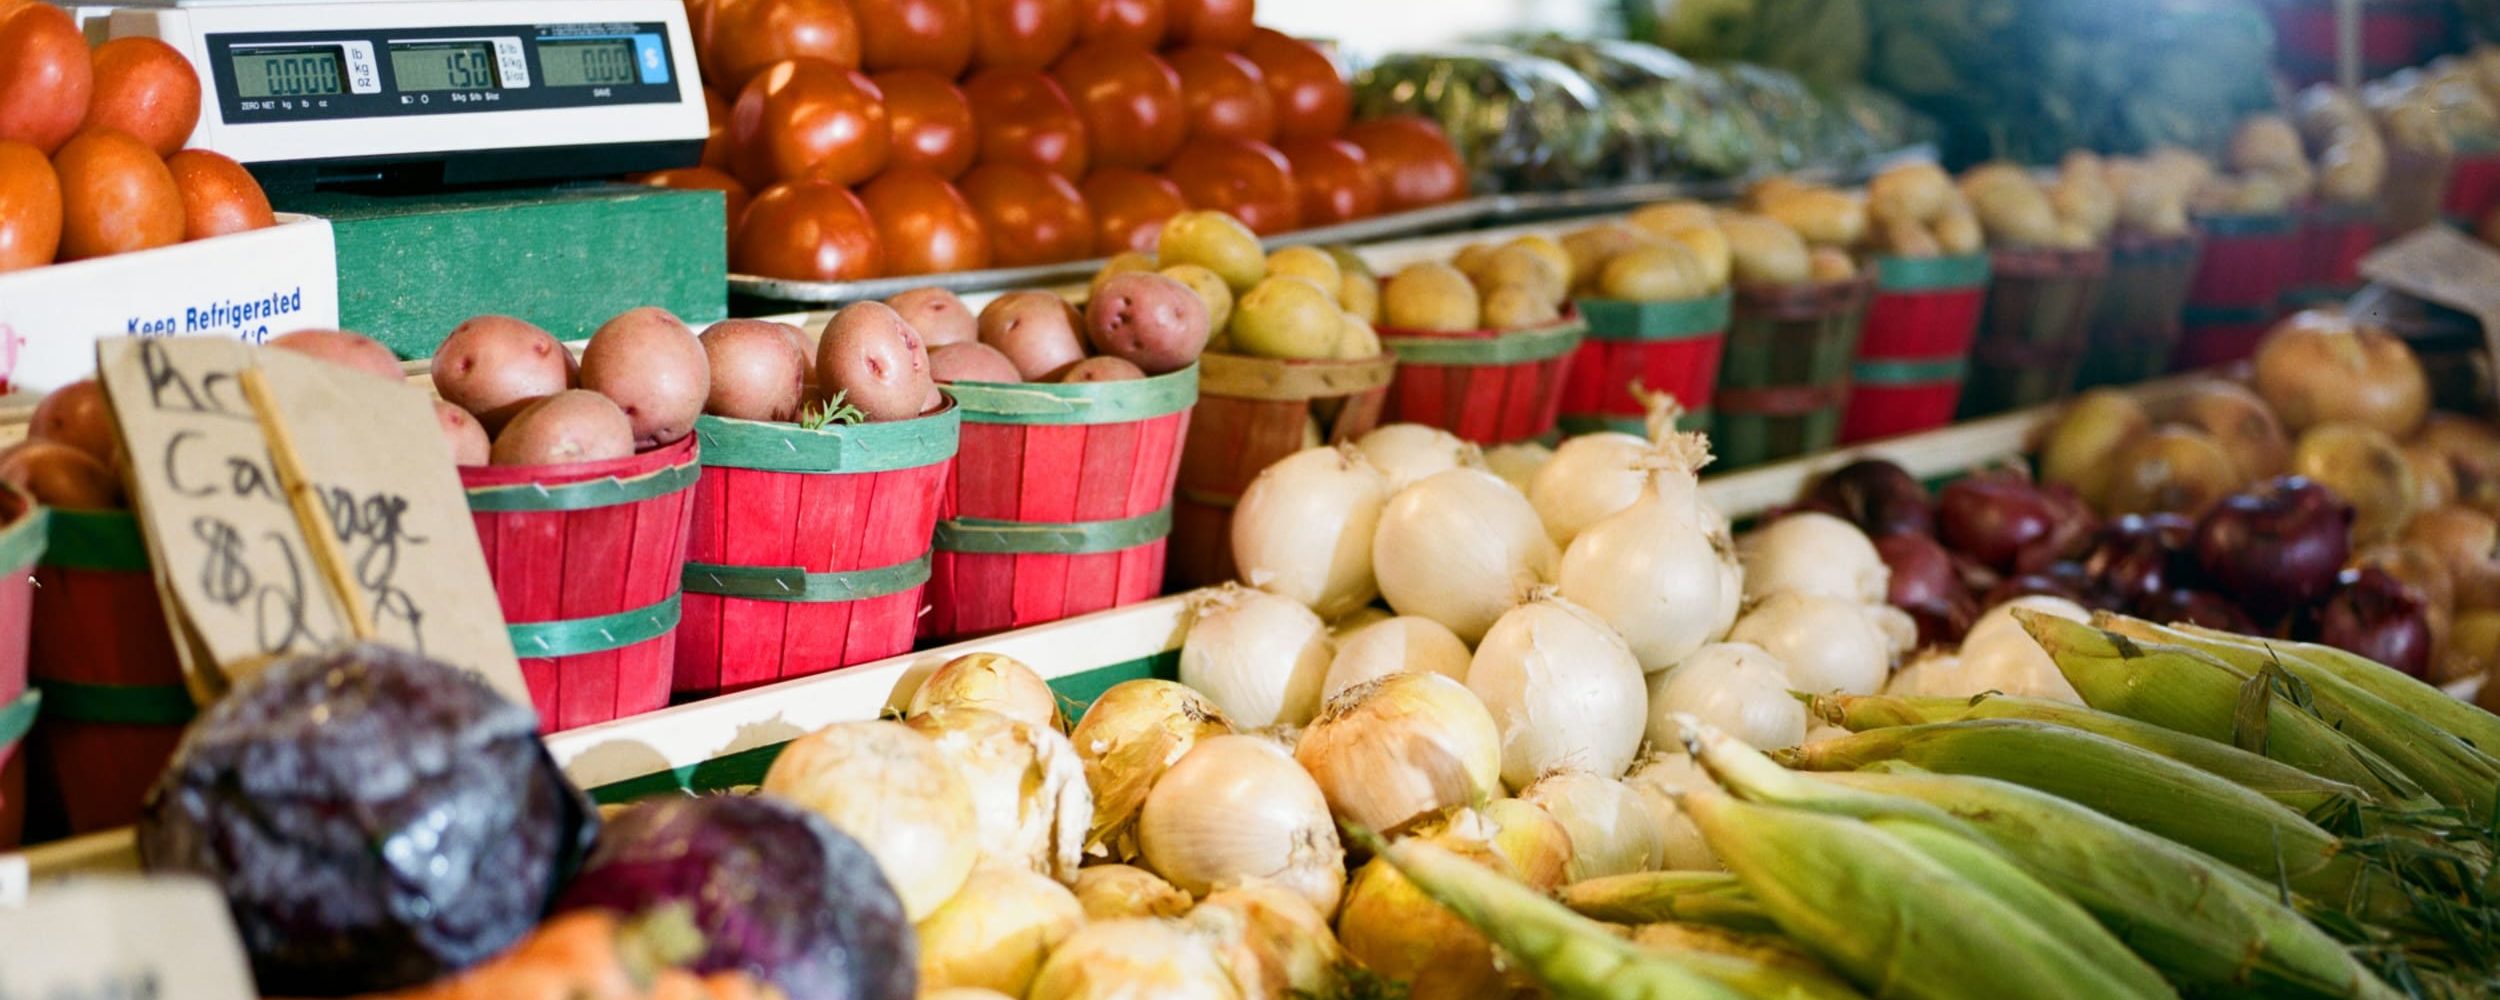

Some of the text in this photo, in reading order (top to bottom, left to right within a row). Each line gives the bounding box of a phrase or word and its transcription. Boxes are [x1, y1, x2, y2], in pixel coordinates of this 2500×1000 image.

[351, 48, 363, 60] lb
[355, 63, 369, 75] kg
[266, 57, 337, 95] 0.000
[358, 78, 371, 87] oz
[241, 101, 260, 111] ZERO
[262, 101, 275, 110] NET
[282, 101, 292, 110] kg
[128, 286, 301, 338] Keep Refrigerated
